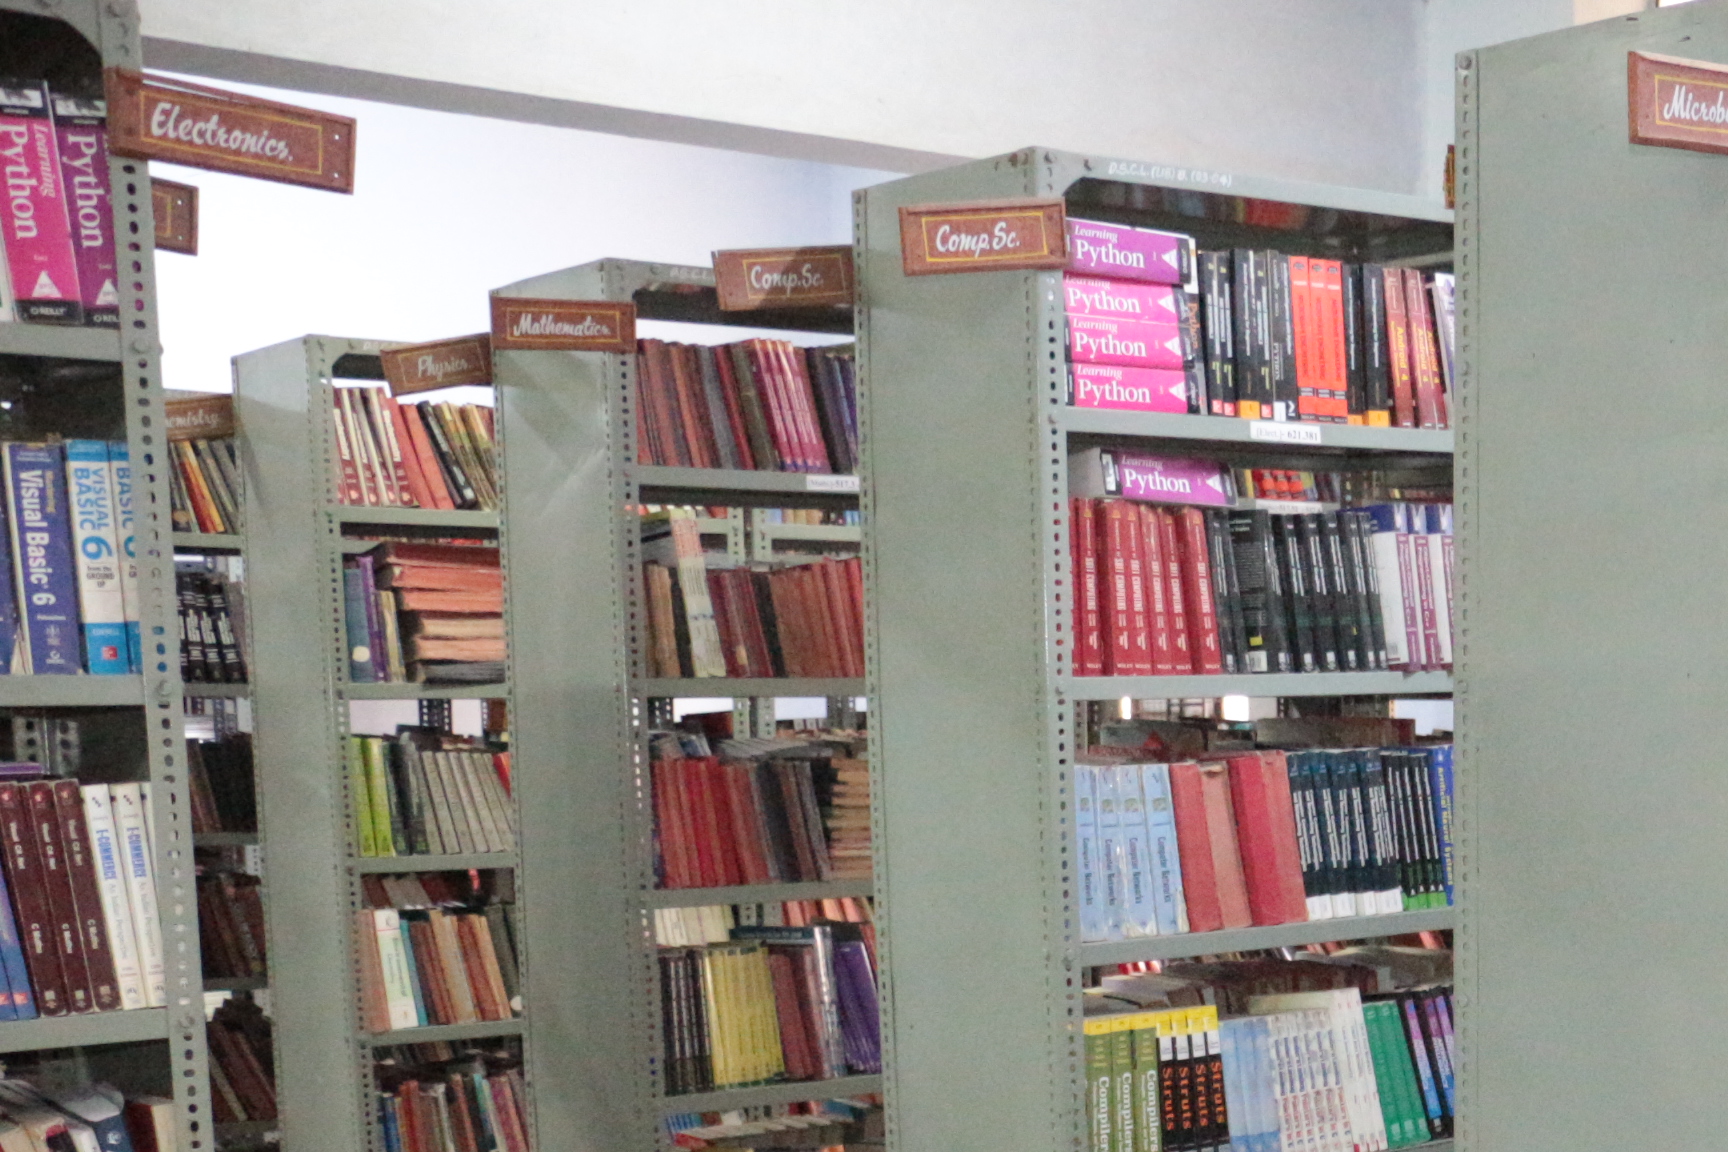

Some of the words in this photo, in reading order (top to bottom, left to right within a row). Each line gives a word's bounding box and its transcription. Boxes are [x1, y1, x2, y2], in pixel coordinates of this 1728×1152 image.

[63, 133, 105, 249] Python
[1074, 225, 1118, 243] Learning
[1075, 240, 1146, 270] Python
[1068, 288, 1141, 316] Python
[1073, 318, 1118, 334] Learning
[1074, 332, 1147, 361] Python
[1396, 327, 1408, 369] Android
[1418, 328, 1428, 369] Android
[1077, 365, 1122, 380] Learning
[1078, 379, 1151, 407] Python
[1121, 455, 1163, 468] Learning
[1124, 467, 1192, 494] Python
[19, 470, 47, 527] Visual
[73, 467, 96, 530] BASIC
[91, 468, 110, 528] VISUAL
[26, 532, 53, 584] Basic
[82, 536, 112, 560] 6
[32, 592, 56, 606] 6
[1146, 1070, 1159, 1152] Compilers
[1163, 1067, 1175, 1130] Struts
[1179, 1066, 1192, 1129] Struts
[1196, 1064, 1208, 1126] Struts
[1211, 1062, 1225, 1123] Struts
